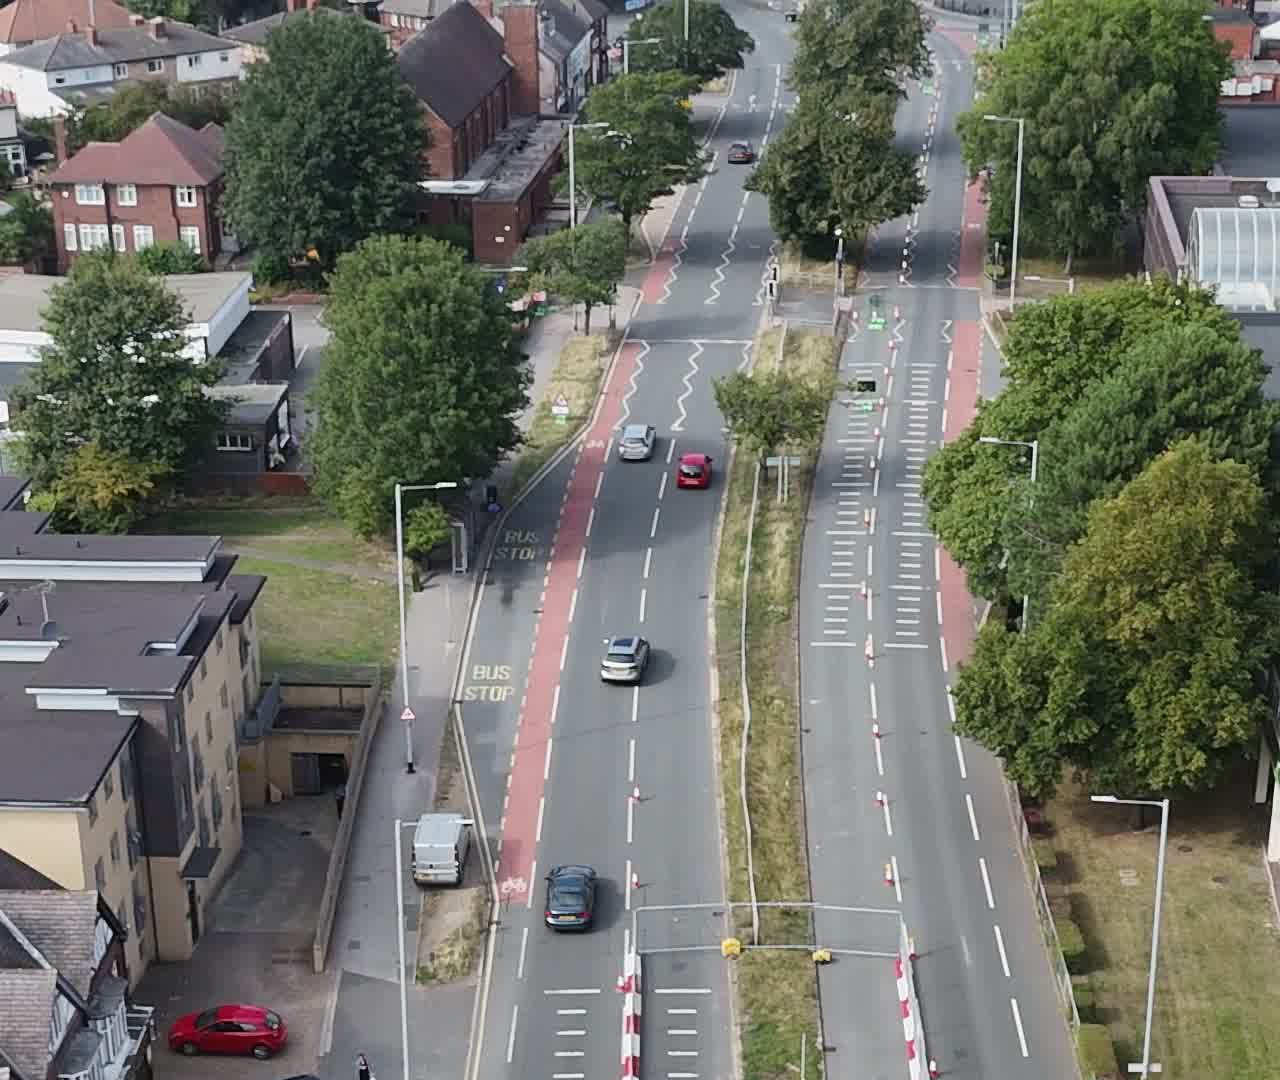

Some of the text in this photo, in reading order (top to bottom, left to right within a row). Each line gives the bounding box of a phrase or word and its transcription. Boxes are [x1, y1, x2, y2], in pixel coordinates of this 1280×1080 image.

[505, 531, 538, 543] BUS
[473, 664, 511, 681] BUS
[464, 686, 515, 701] STOP
